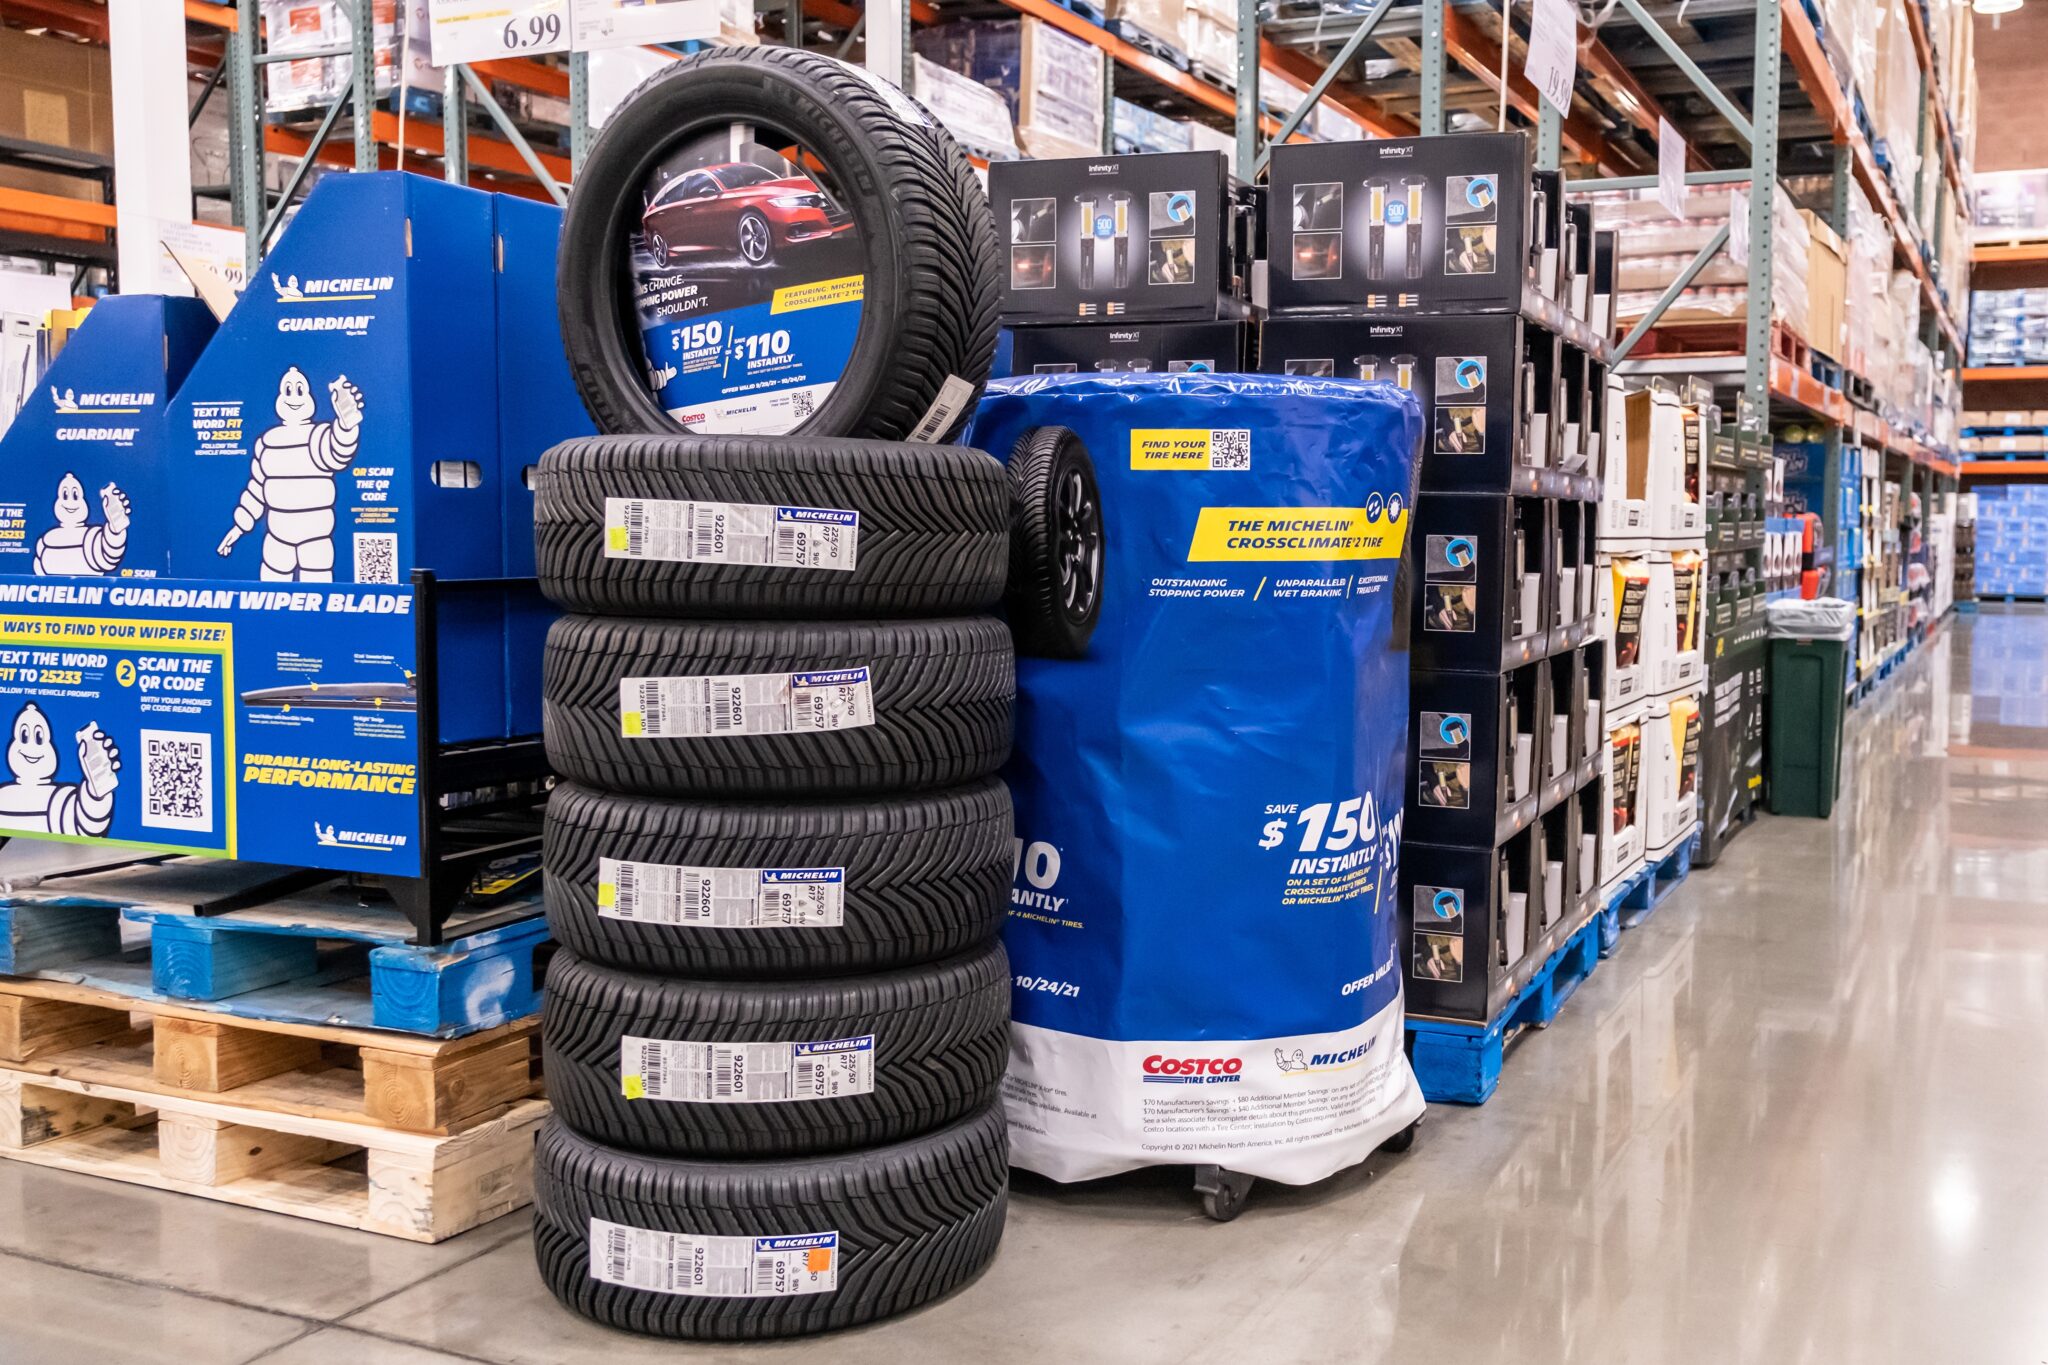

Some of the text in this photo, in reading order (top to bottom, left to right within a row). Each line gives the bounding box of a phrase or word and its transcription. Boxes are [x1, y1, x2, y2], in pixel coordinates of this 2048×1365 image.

[503, 14, 561, 49] 6.99
[1380, 147, 1405, 155] Infinity
[1089, 165, 1112, 174] Infinity
[1388, 204, 1404, 216] 500
[1097, 218, 1112, 230] 500
[304, 277, 394, 294] MICHELIN
[648, 274, 685, 292] CHANGE.
[661, 285, 698, 303] POWER
[784, 286, 828, 299] FEATURING:
[657, 297, 709, 317] SHOULDN'T.
[1110, 332, 1132, 340] Infinity
[1370, 326, 1395, 335] Infinity
[683, 346, 722, 360] INSTANTLY
[747, 354, 793, 370] INSTANTLY
[80, 393, 155, 406] MICHELIN
[193, 407, 240, 417] TEXT THE
[726, 406, 757, 416] MICHELIN
[192, 418, 243, 429] WORD FIT
[197, 431, 211, 440] TO
[1145, 451, 1204, 459] TIRE HERE
[352, 467, 394, 476] OR SCAN
[356, 480, 390, 491] THE QR
[361, 492, 387, 501] CODE
[6, 508, 23, 517] THE
[795, 511, 853, 522] MICHELIN
[11, 519, 26, 528] FIT
[1228, 520, 1264, 532] THE
[714, 514, 725, 554] 922601
[822, 525, 830, 542] R17
[796, 531, 806, 566] 69757
[829, 526, 839, 558] 225/50
[1362, 537, 1383, 547] TIRE
[134, 569, 156, 578] SCAN
[1151, 578, 1227, 587] OUTSTANDING
[1276, 578, 1346, 587] UNPARALLELED
[1148, 588, 1245, 597] STOPPING POWER
[1273, 589, 1342, 598] WET BRAKING
[239, 591, 323, 612] WIPER
[325, 593, 412, 615] BLADE
[3, 621, 226, 641] WAYS TO FIND YOUR WIPER SIZE!
[32, 652, 108, 668] THE WORD
[137, 656, 213, 674] SCAN THE
[0, 668, 17, 681] FIT
[19, 669, 38, 682] TO
[39, 670, 82, 684] 25233
[138, 675, 205, 692] QR CODE
[38, 688, 66, 697] VEHICLE
[66, 690, 100, 698] PROMPTS
[140, 696, 159, 704] WITH
[160, 697, 180, 705] YOUR
[731, 687, 741, 727] 922601
[140, 704, 151, 713] QR
[172, 706, 201, 714] READER
[813, 696, 824, 729] 69757
[243, 753, 416, 776] DURABLE LONG-LASTING
[243, 766, 417, 795] PERFORMANCE
[1264, 804, 1299, 814] SAVE
[338, 830, 407, 846] MICHELIN
[1289, 844, 1377, 874] INSTANTLY
[780, 871, 838, 880] MICHELIN
[1312, 878, 1329, 886] SET
[1354, 877, 1367, 887] TIRES
[1360, 883, 1374, 895] TIRES
[701, 879, 711, 917] 922601
[816, 885, 825, 916] 225/50
[782, 893, 792, 925] 69757
[1016, 975, 1081, 998] 10/24/21
[1341, 973, 1374, 996] OFFER
[813, 1038, 871, 1051] MICHELIN
[1310, 1036, 1377, 1066] MICHELIN
[848, 1053, 856, 1084] 225/50
[1142, 1055, 1242, 1075] COSTCO
[734, 1054, 743, 1094] 922601
[815, 1063, 824, 1096] 69757
[1184, 1075, 1240, 1084] TIRE CENTER
[1283, 1091, 1306, 1099] Member
[1250, 1103, 1282, 1111] Additional
[1283, 1100, 1306, 1108] Member
[1217, 1114, 1247, 1123] complete
[1141, 1144, 1177, 1152] Copyright
[1227, 1141, 1246, 1149] North
[774, 1236, 833, 1249] MICHELIN
[694, 1247, 704, 1286] 922601
[775, 1260, 785, 1294] 69757
